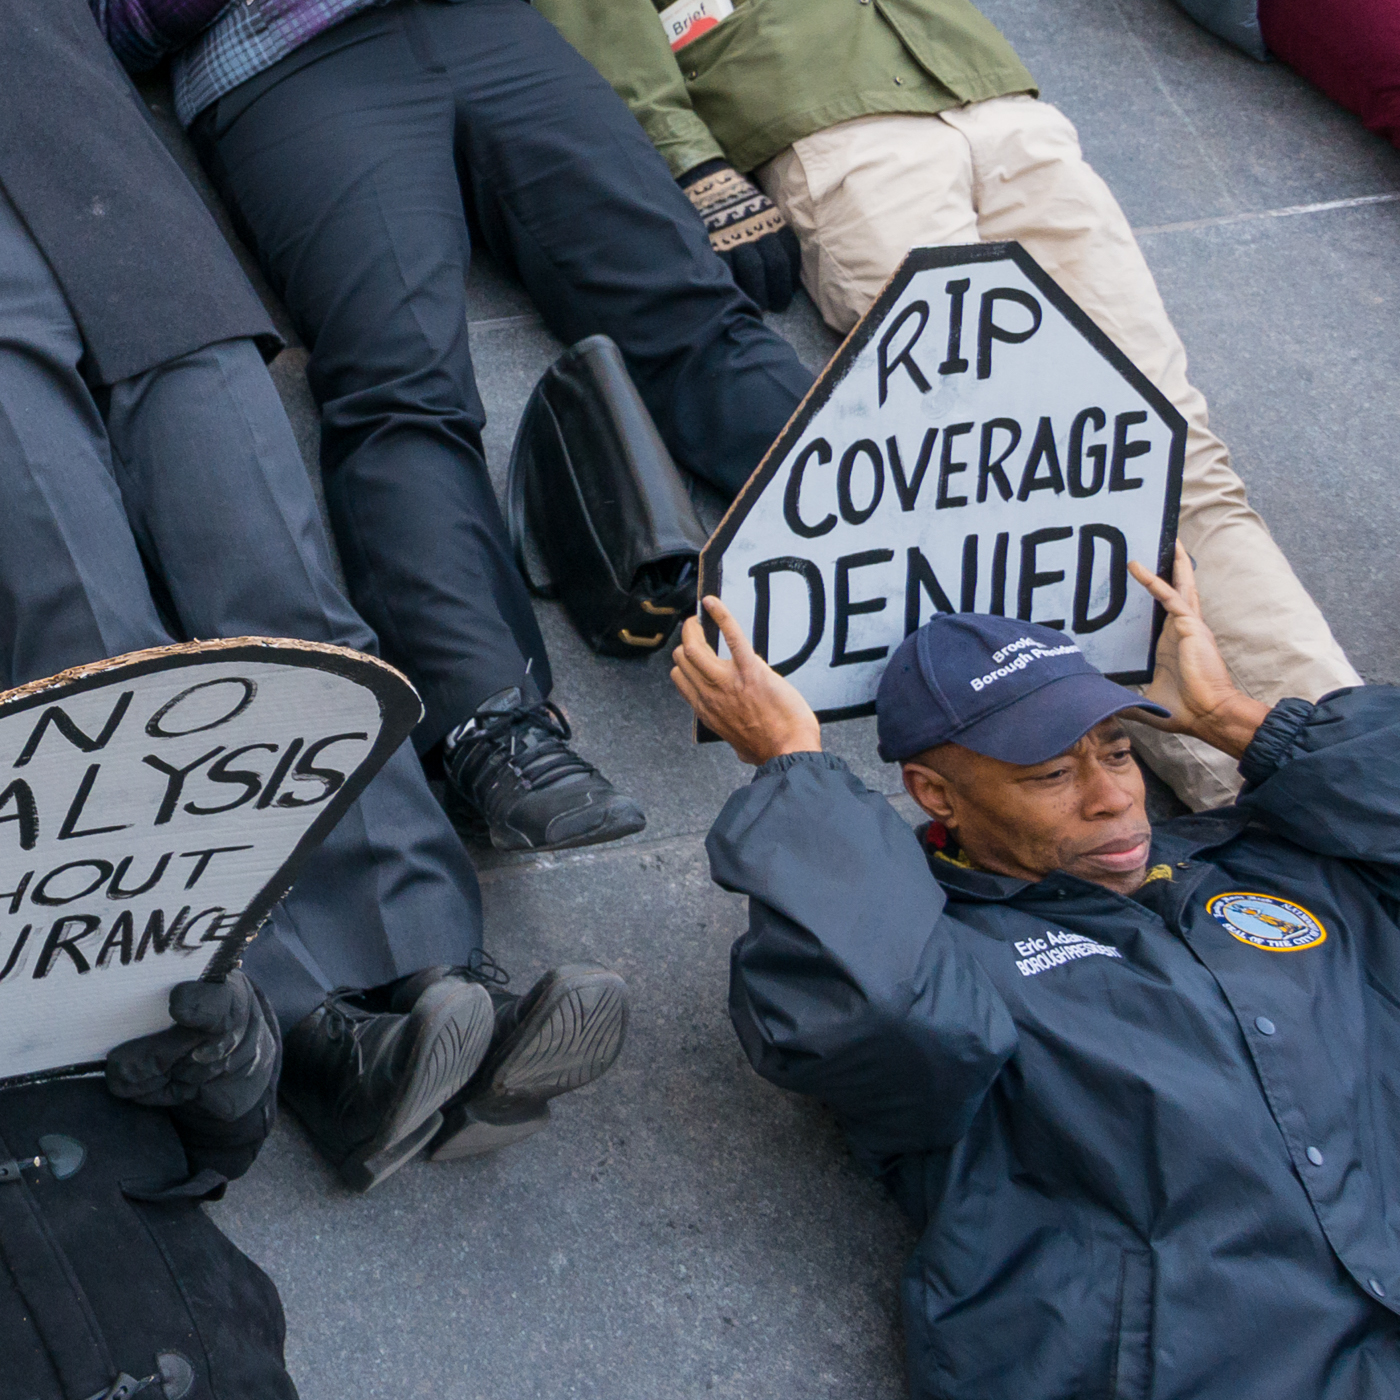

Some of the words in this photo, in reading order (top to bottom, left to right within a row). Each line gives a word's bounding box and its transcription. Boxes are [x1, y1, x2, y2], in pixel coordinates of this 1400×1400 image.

[672, 2, 706, 35] Brief
[877, 278, 1044, 409] RIP
[782, 406, 1152, 539] COVERAGE
[747, 522, 1128, 678] DENIED
[970, 653, 1034, 692] Borough
[13, 677, 259, 768] NO
[1014, 937, 1048, 957] Eric
[1015, 946, 1071, 976] BOROUGH
[1249, 936, 1265, 945] OF
[1267, 939, 1293, 947] THE
